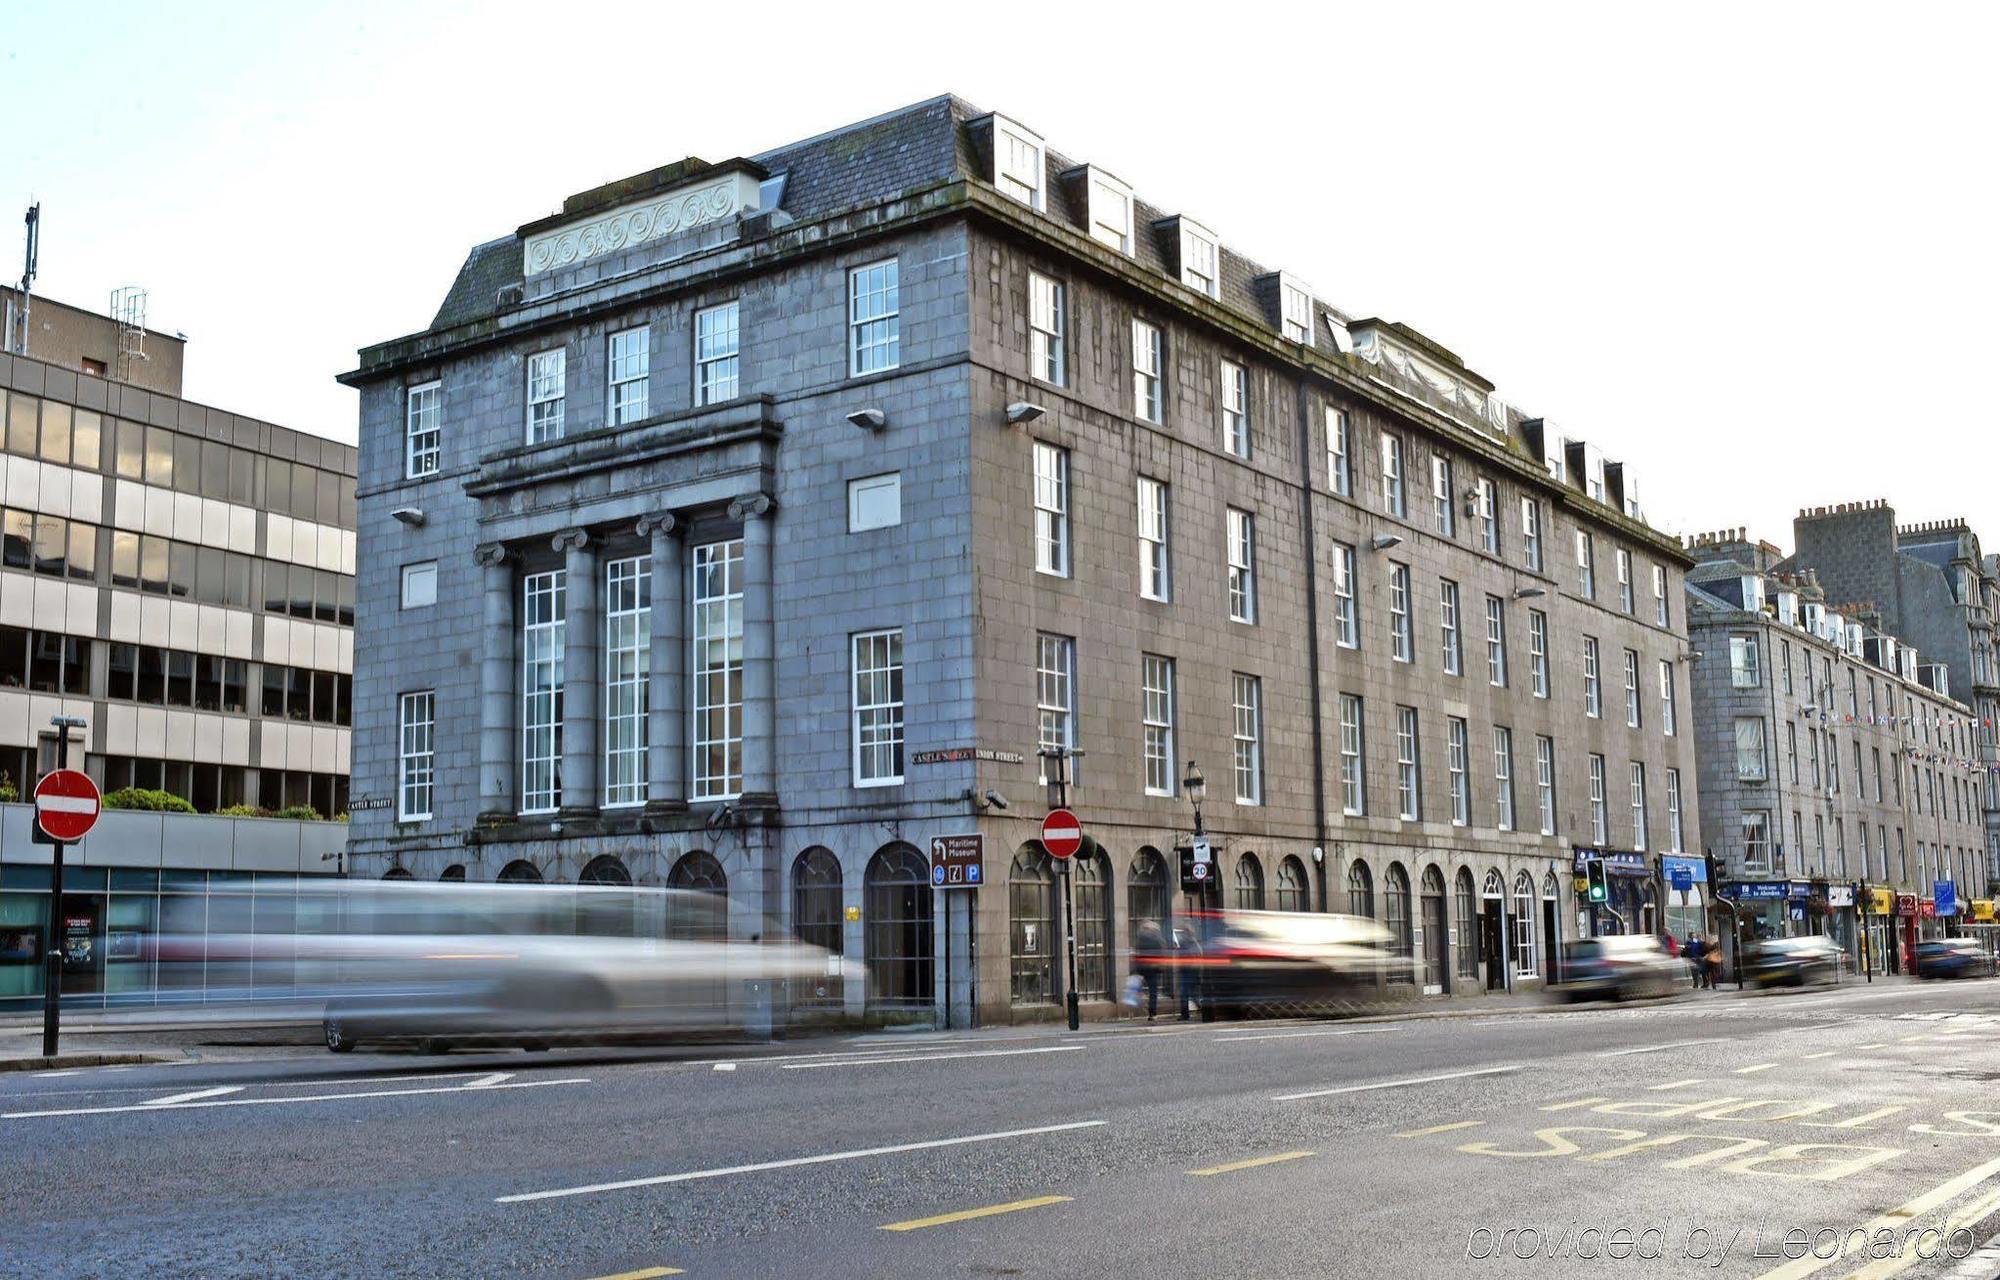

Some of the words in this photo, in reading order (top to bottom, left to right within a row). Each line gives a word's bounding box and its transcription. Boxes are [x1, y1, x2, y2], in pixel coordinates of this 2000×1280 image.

[912, 753, 942, 765] CASTLE
[976, 750, 995, 760] UNION
[996, 752, 1018, 762] STREET
[347, 801, 368, 809] CASTLE
[369, 799, 391, 808] STREET
[948, 839, 978, 848] Maritime
[948, 849, 977, 857] Museum
[969, 866, 978, 881] P
[1194, 866, 1205, 876] 20
[1457, 1126, 1908, 1181] BUS
